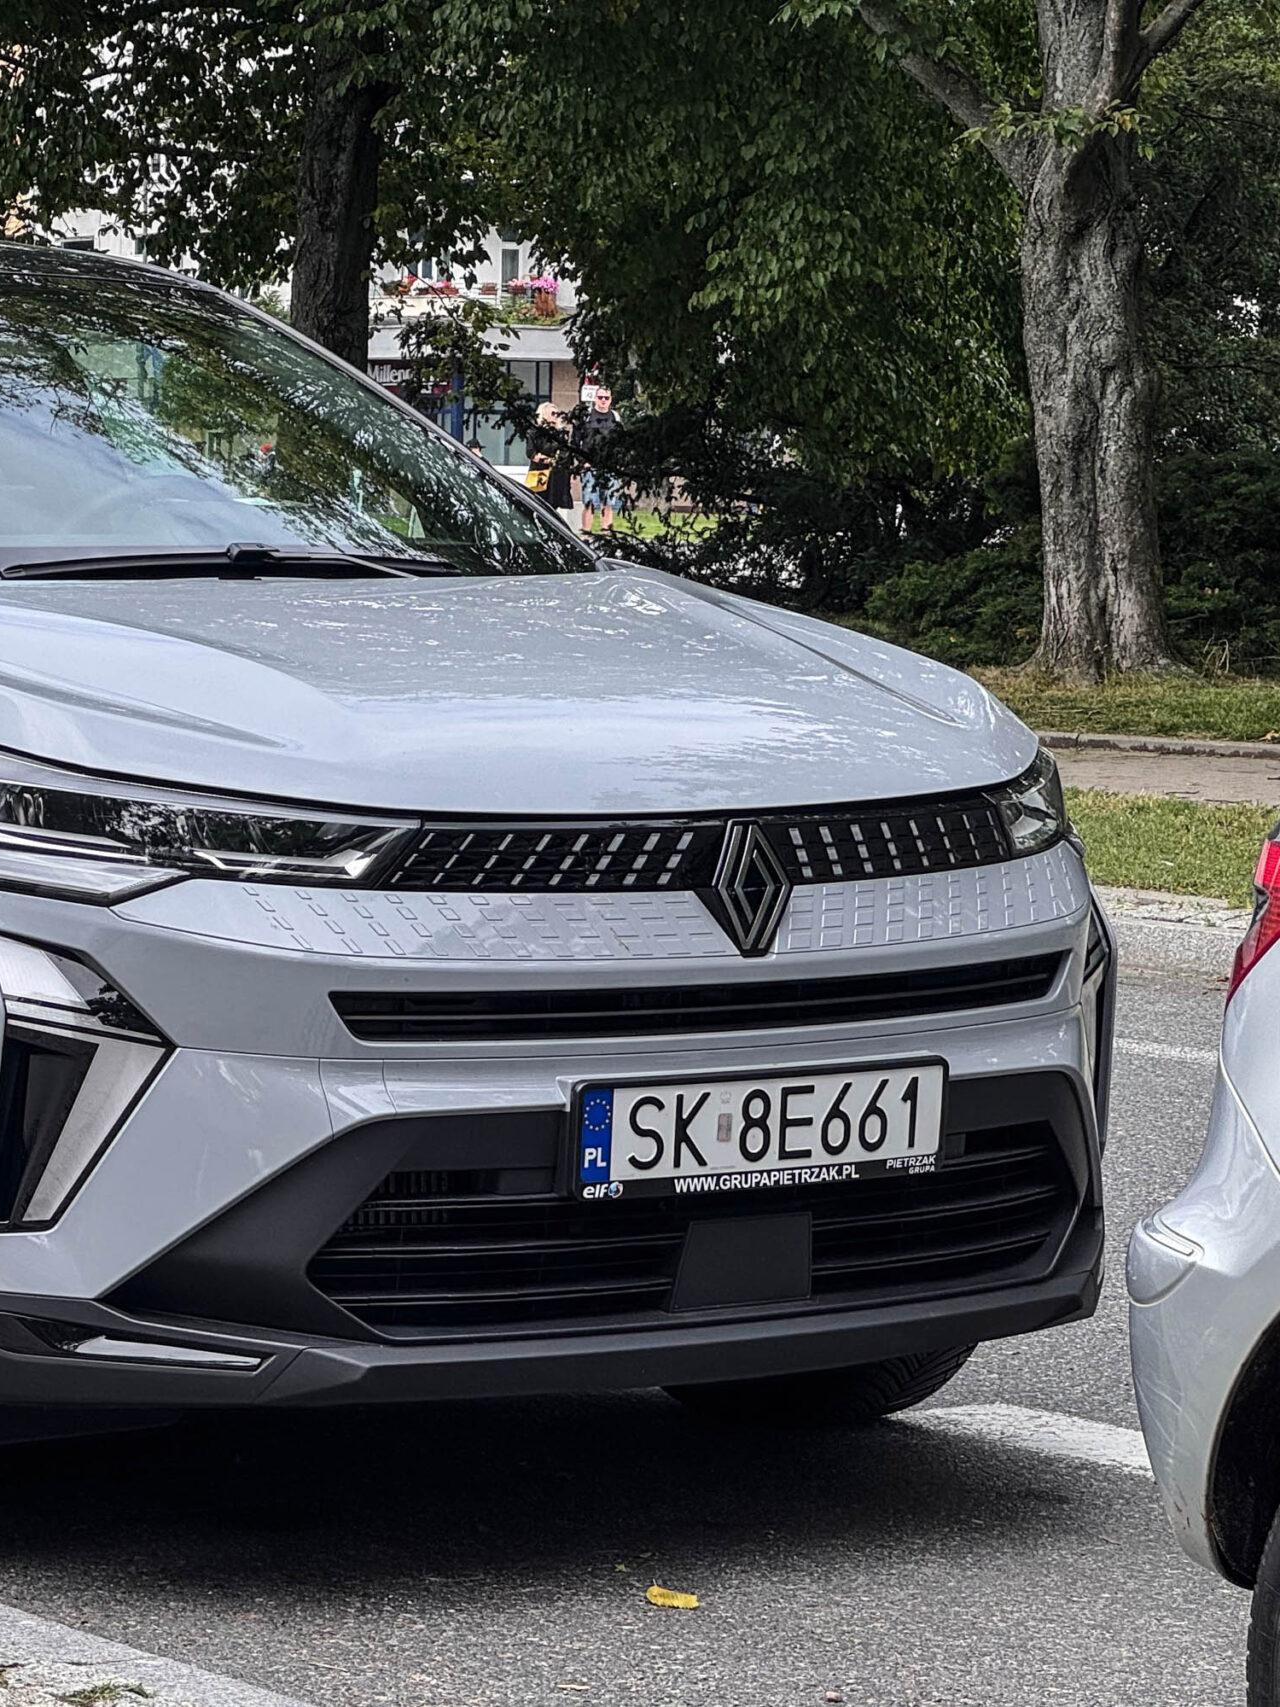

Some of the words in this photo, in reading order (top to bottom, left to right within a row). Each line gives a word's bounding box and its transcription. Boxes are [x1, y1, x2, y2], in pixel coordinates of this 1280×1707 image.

[627, 1092, 711, 1170] SK
[739, 1076, 919, 1162] 8E661
[584, 1148, 607, 1168] PL
[886, 1154, 936, 1169] PIETRZAK
[908, 1165, 935, 1174] GRUPA
[674, 1164, 860, 1193] WWW.GRUPAPIETRZAK.PL
[582, 1184, 608, 1199] elf
